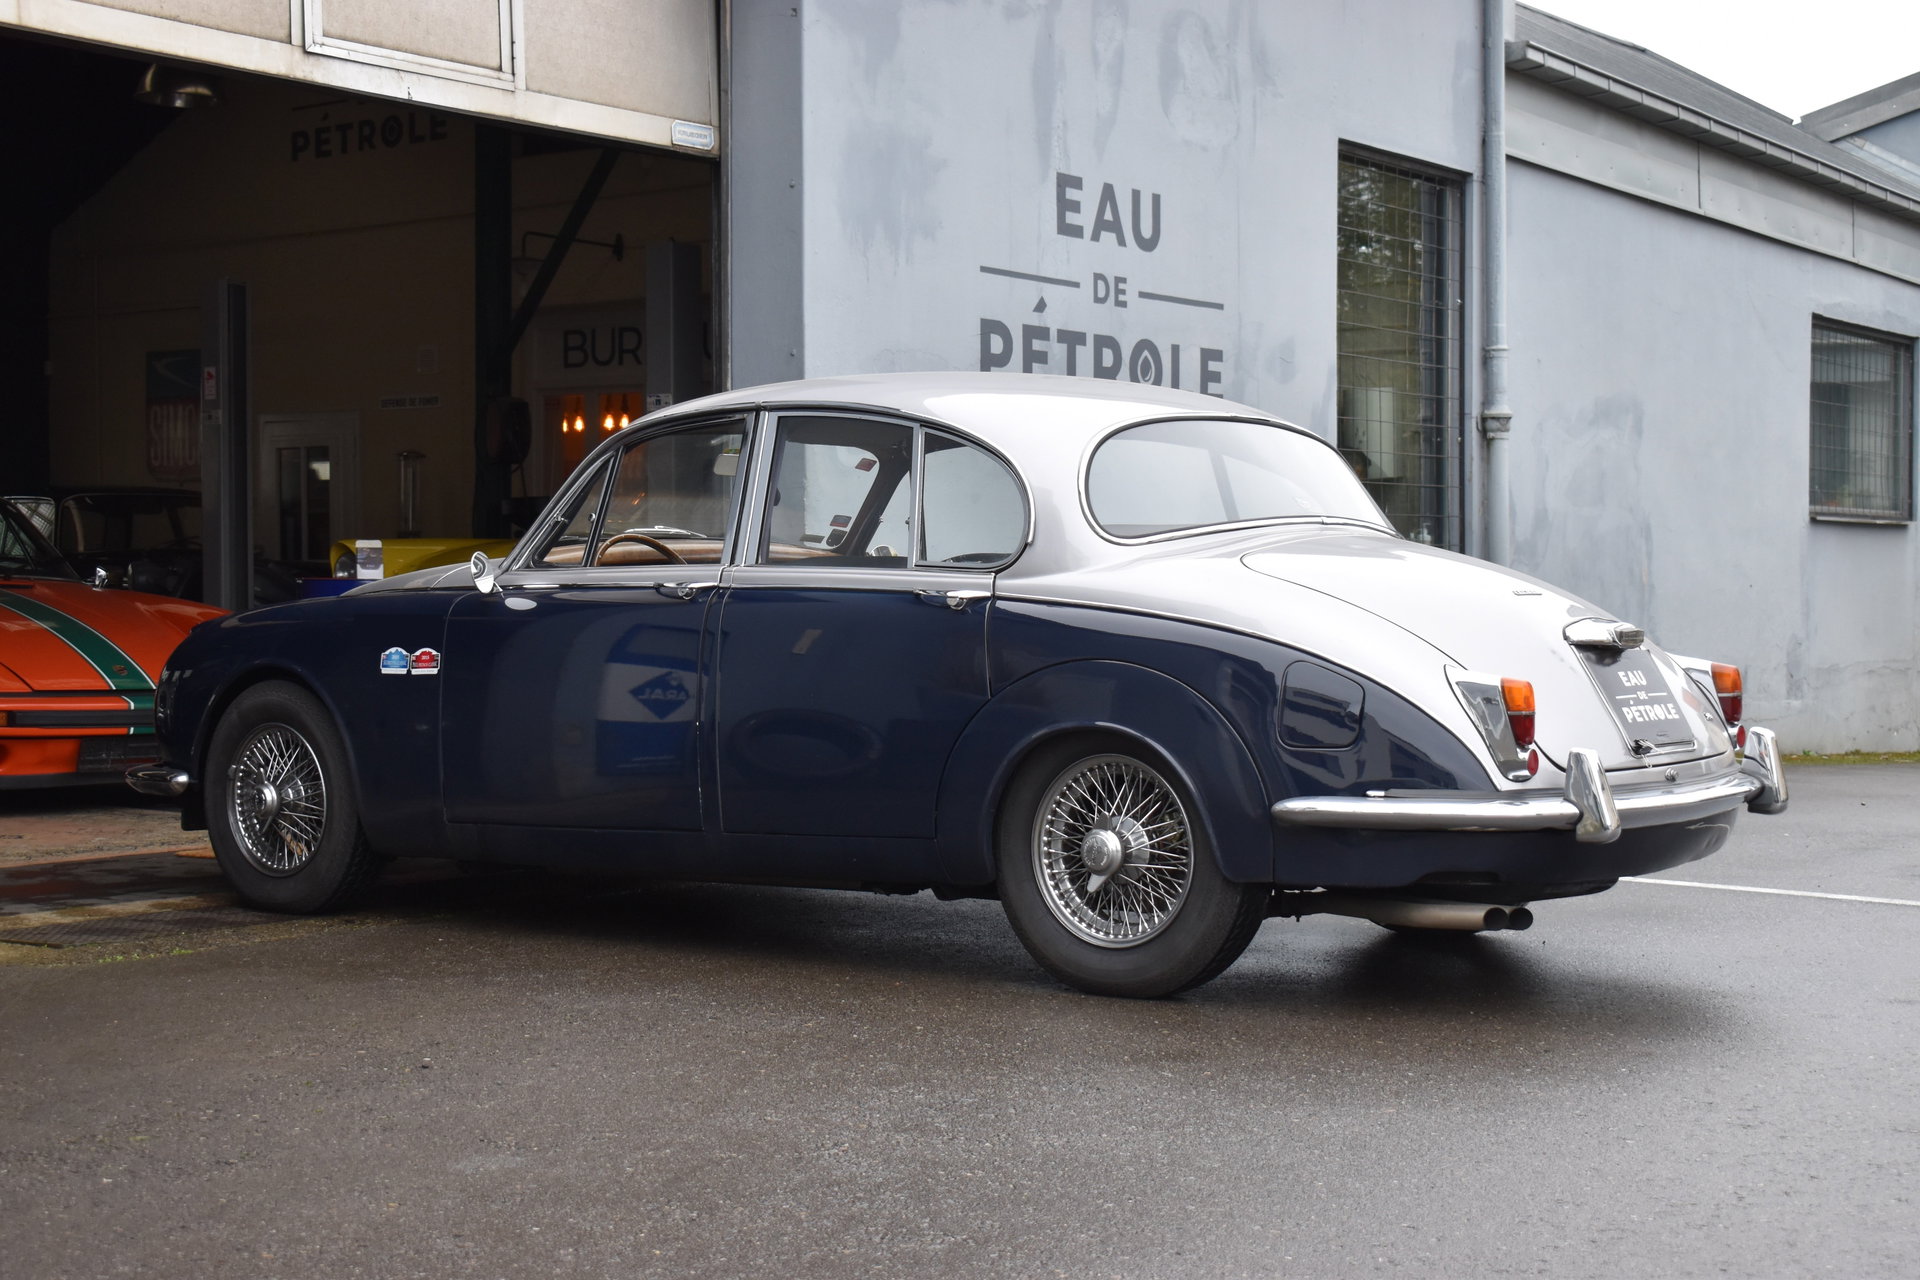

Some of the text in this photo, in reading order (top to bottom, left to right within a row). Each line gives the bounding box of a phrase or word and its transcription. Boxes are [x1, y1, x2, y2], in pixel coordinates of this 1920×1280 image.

[291, 112, 448, 162] PÉTROLE
[1056, 171, 1161, 253] EAU
[1093, 272, 1127, 308] DE
[980, 296, 1224, 399] PÉTROLE
[1617, 670, 1647, 687] EAU
[1636, 691, 1648, 700] DE
[1621, 699, 1680, 723] PÉTROLE
